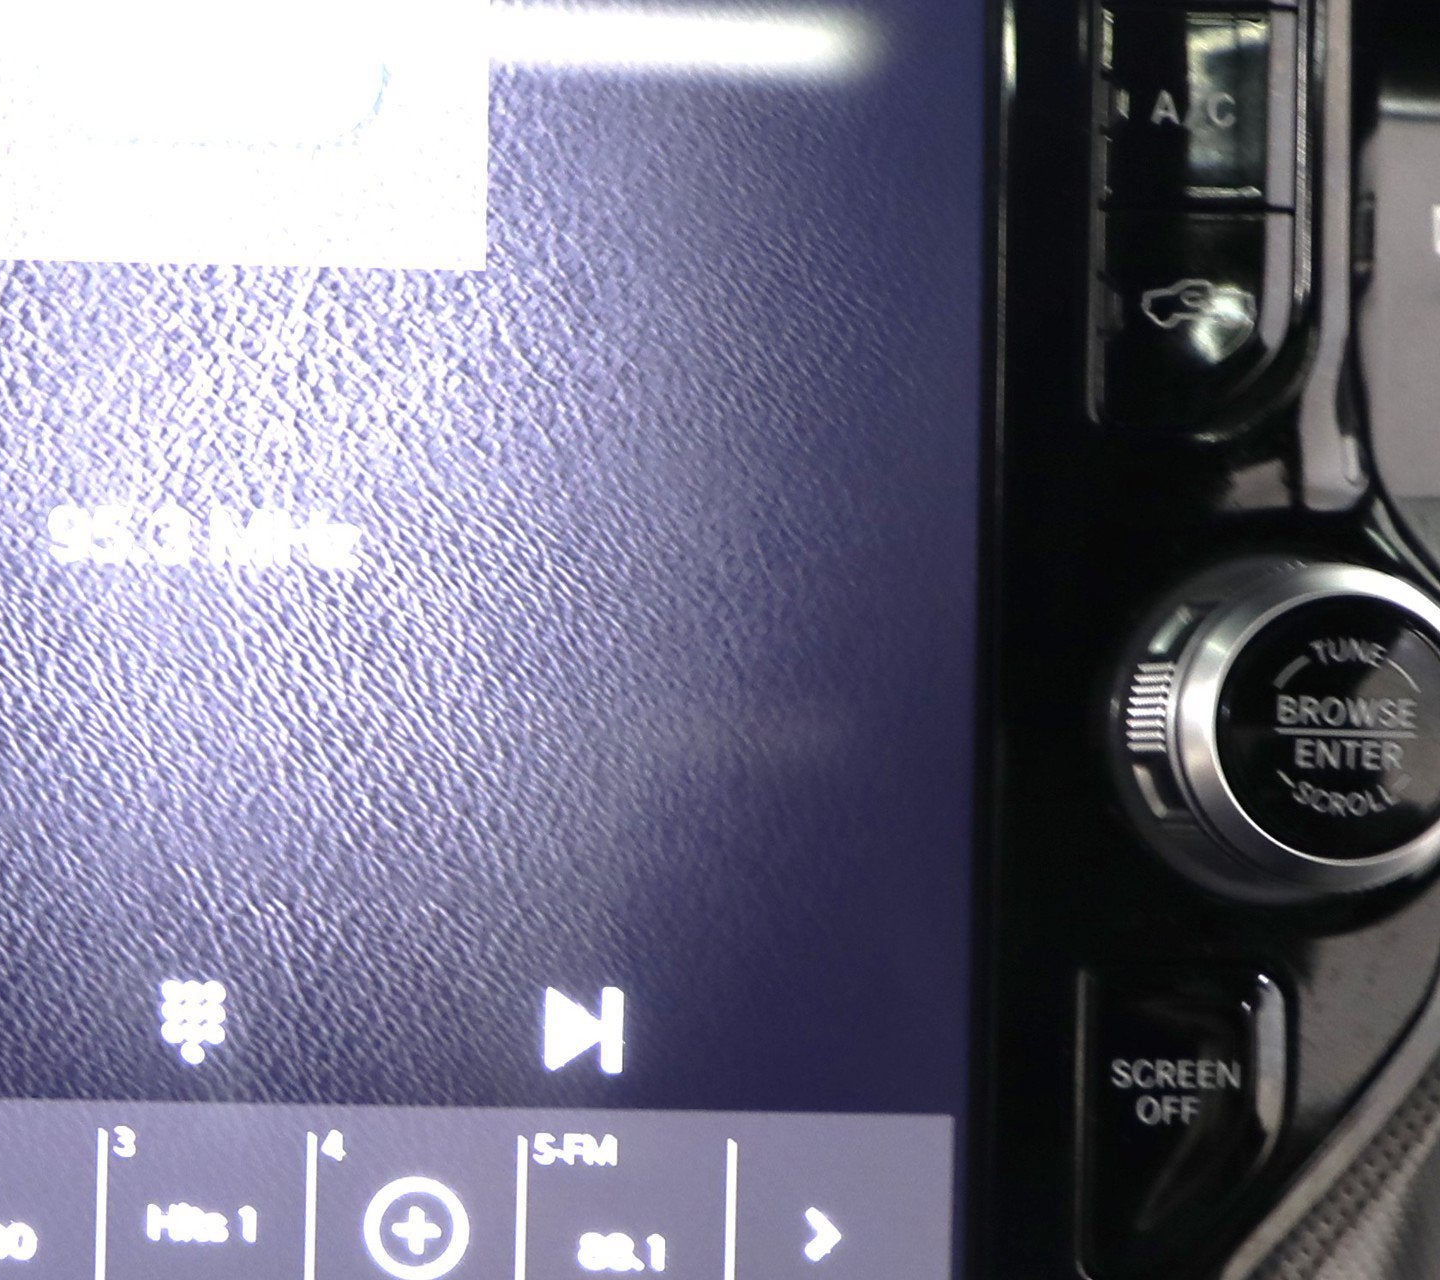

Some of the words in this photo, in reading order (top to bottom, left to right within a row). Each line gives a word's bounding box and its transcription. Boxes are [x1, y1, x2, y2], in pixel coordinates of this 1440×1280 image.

[1309, 638, 1388, 667] TUNE
[1276, 694, 1417, 728] BROWSE
[1294, 738, 1404, 769] ENTER
[1293, 779, 1398, 818] SCROLL
[1111, 1058, 1241, 1091] SCREEN
[1135, 1094, 1200, 1126] OFF
[113, 1126, 137, 1158] 3
[321, 1130, 347, 1161] 4
[533, 1134, 617, 1166] 5-FM
[238, 1205, 258, 1243] 1
